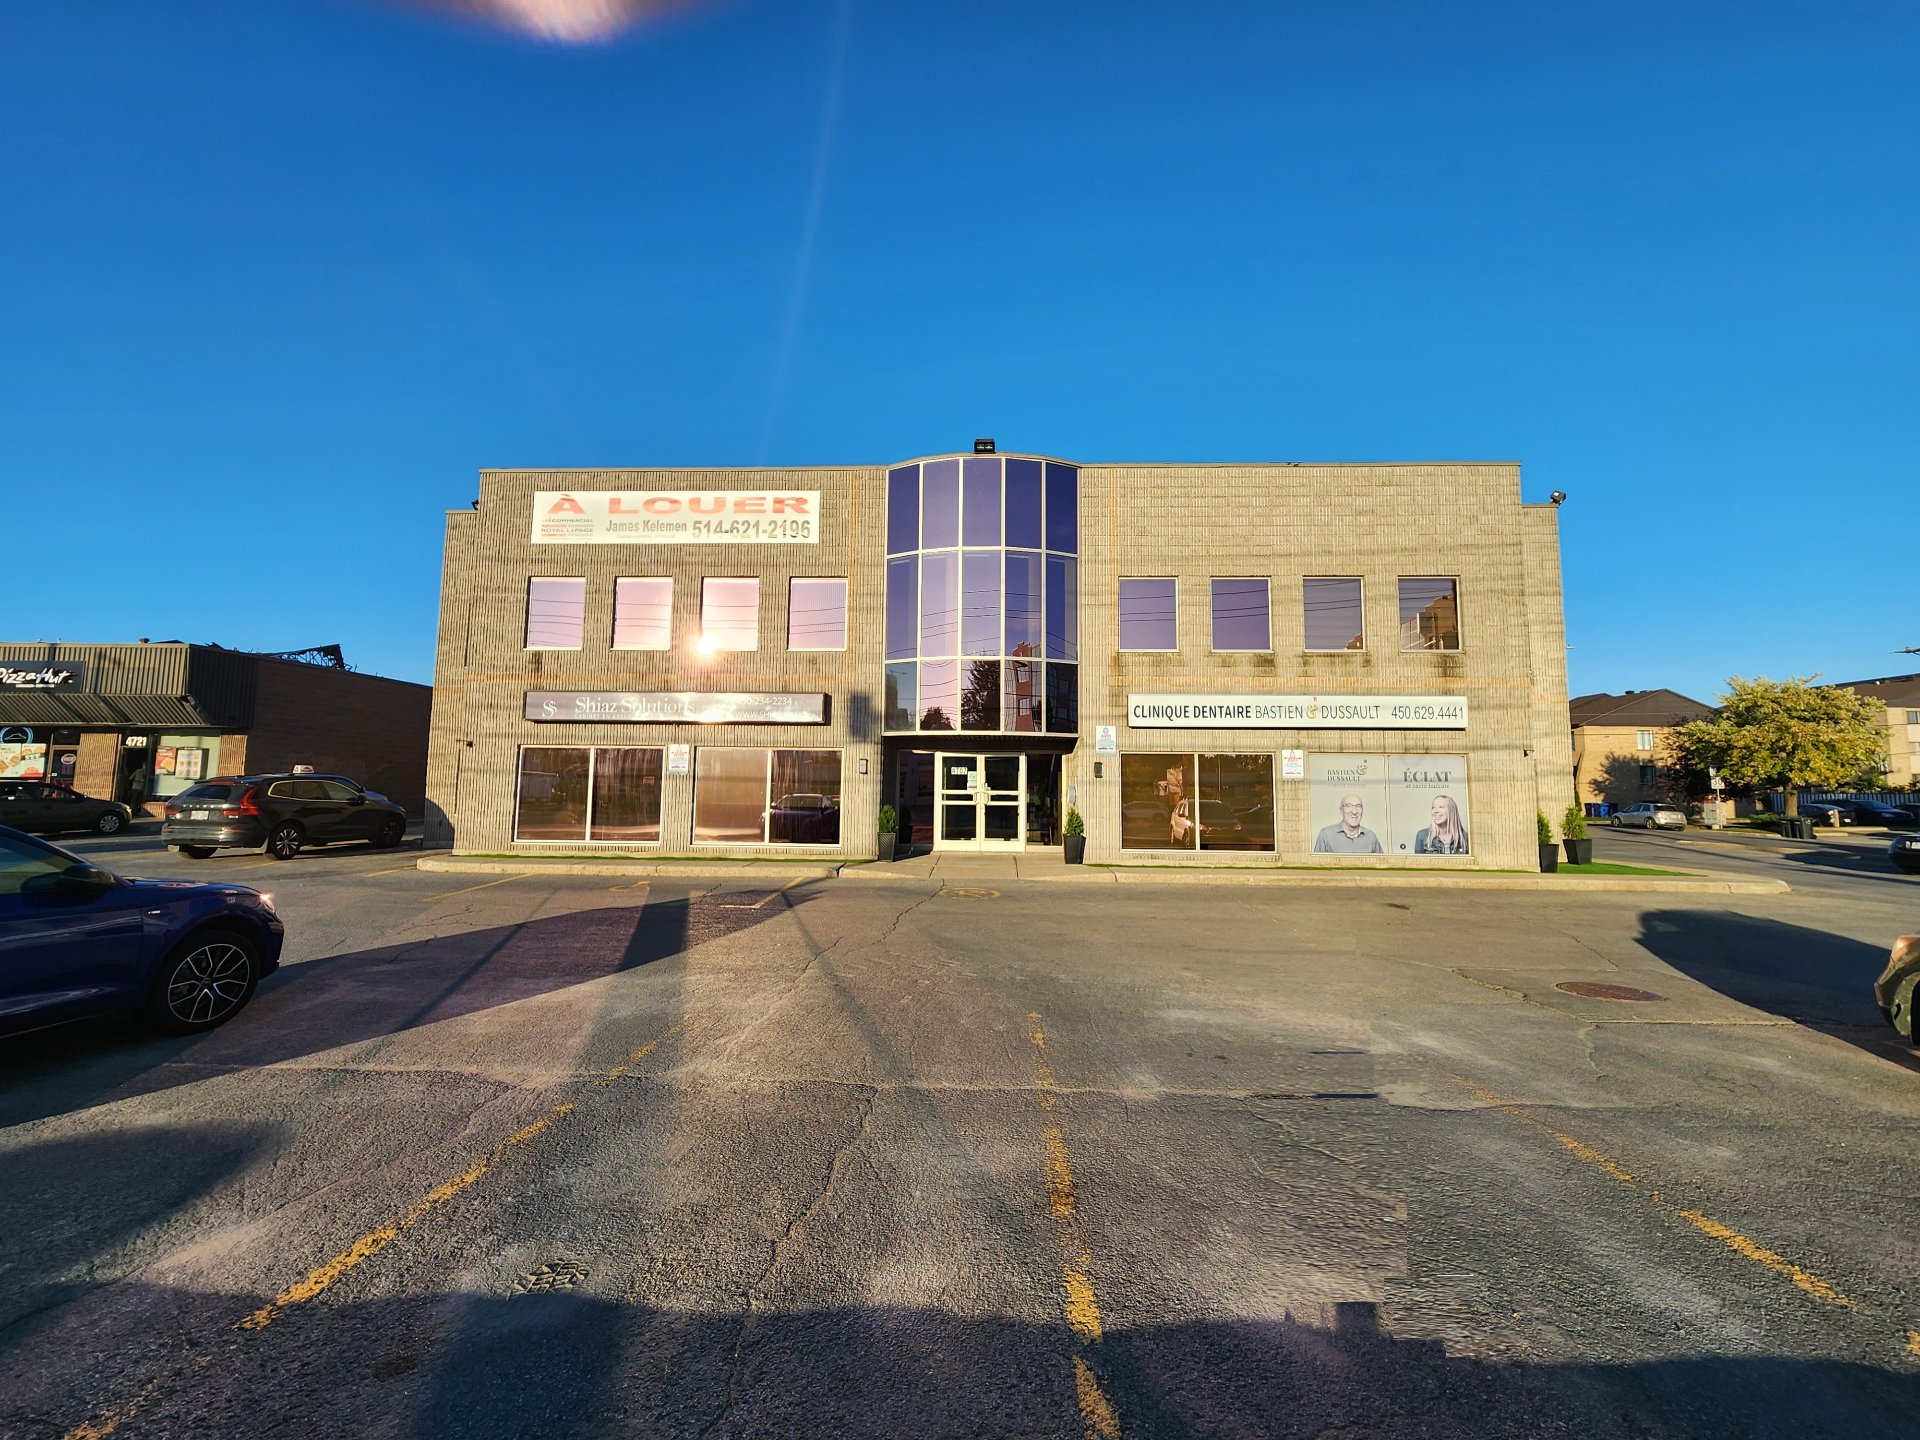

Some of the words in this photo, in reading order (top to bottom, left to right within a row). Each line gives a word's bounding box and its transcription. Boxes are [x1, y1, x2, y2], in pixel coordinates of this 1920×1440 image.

[547, 493, 587, 515] À
[608, 497, 811, 515] LOUER
[606, 519, 640, 533] James
[642, 519, 688, 533] Kelemen
[692, 519, 811, 539] 514-621-2196
[0, 667, 37, 684] Pizza
[36, 667, 71, 684] Hut
[575, 696, 618, 713] Shiaz
[621, 696, 696, 714] Solutions
[1133, 705, 1190, 721] CLINIQUE
[1193, 705, 1252, 719] DENTAIRE
[1255, 705, 1303, 719] BASTIEN
[1306, 703, 1319, 720] &
[1321, 705, 1381, 719] DUSSAULT
[1391, 706, 1464, 720] 450.629.4441
[125, 736, 148, 747] 4721
[1403, 768, 1452, 782] ÉCLAT
